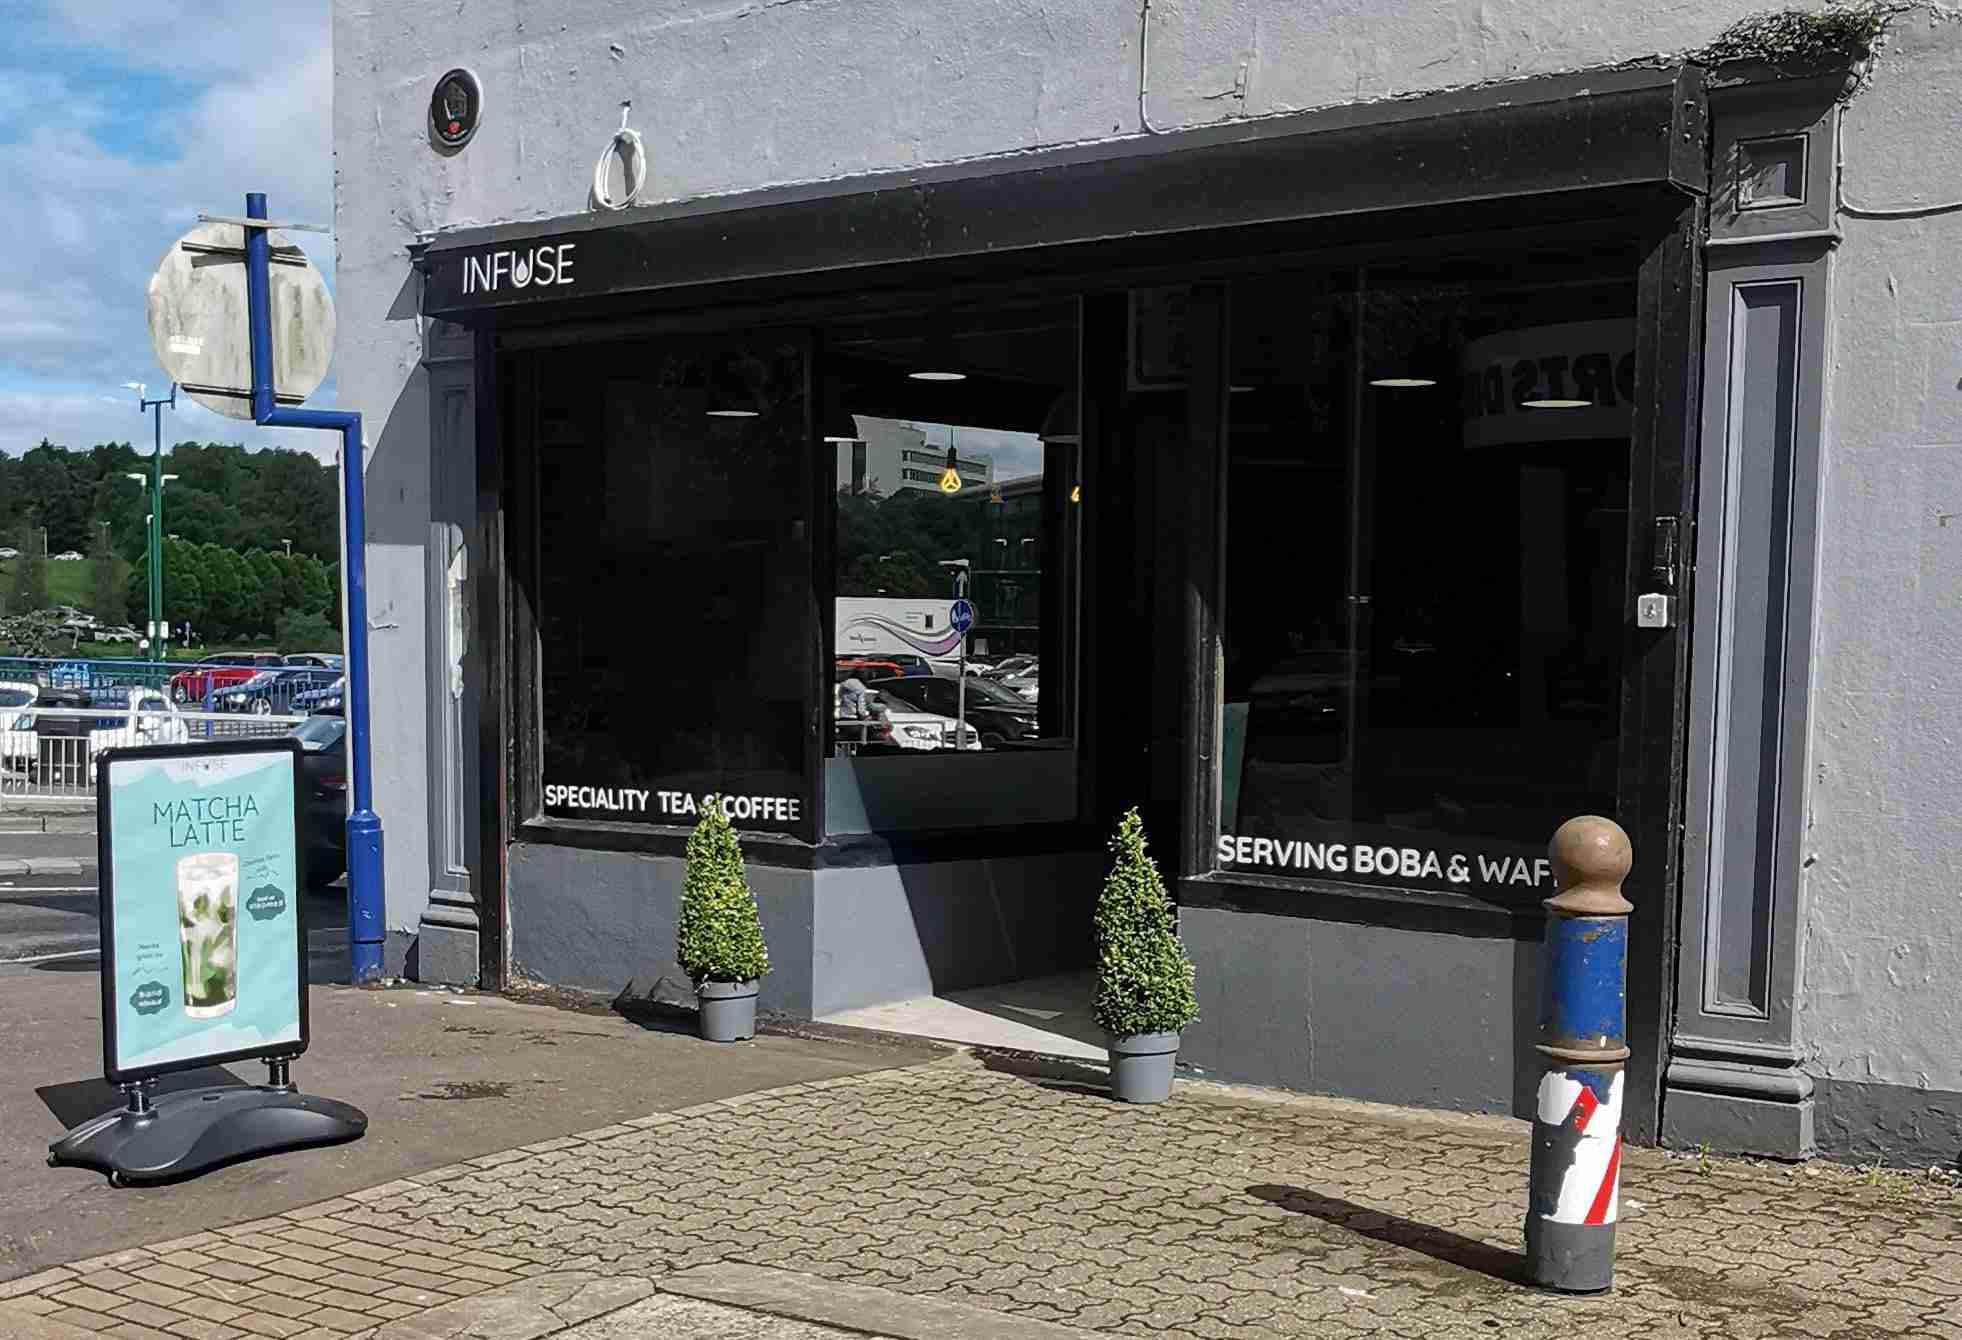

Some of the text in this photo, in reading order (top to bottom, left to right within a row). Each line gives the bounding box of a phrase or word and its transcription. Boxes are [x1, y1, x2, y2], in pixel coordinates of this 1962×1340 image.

[462, 243, 576, 294] INFUSE
[153, 794, 260, 825] MATCHA
[544, 784, 650, 812] SPECIALITY
[657, 790, 697, 815] TEA
[720, 795, 801, 821] COFFEE
[170, 818, 246, 848] LATTE
[1216, 834, 1559, 888] SERVING BOBA & WAF
